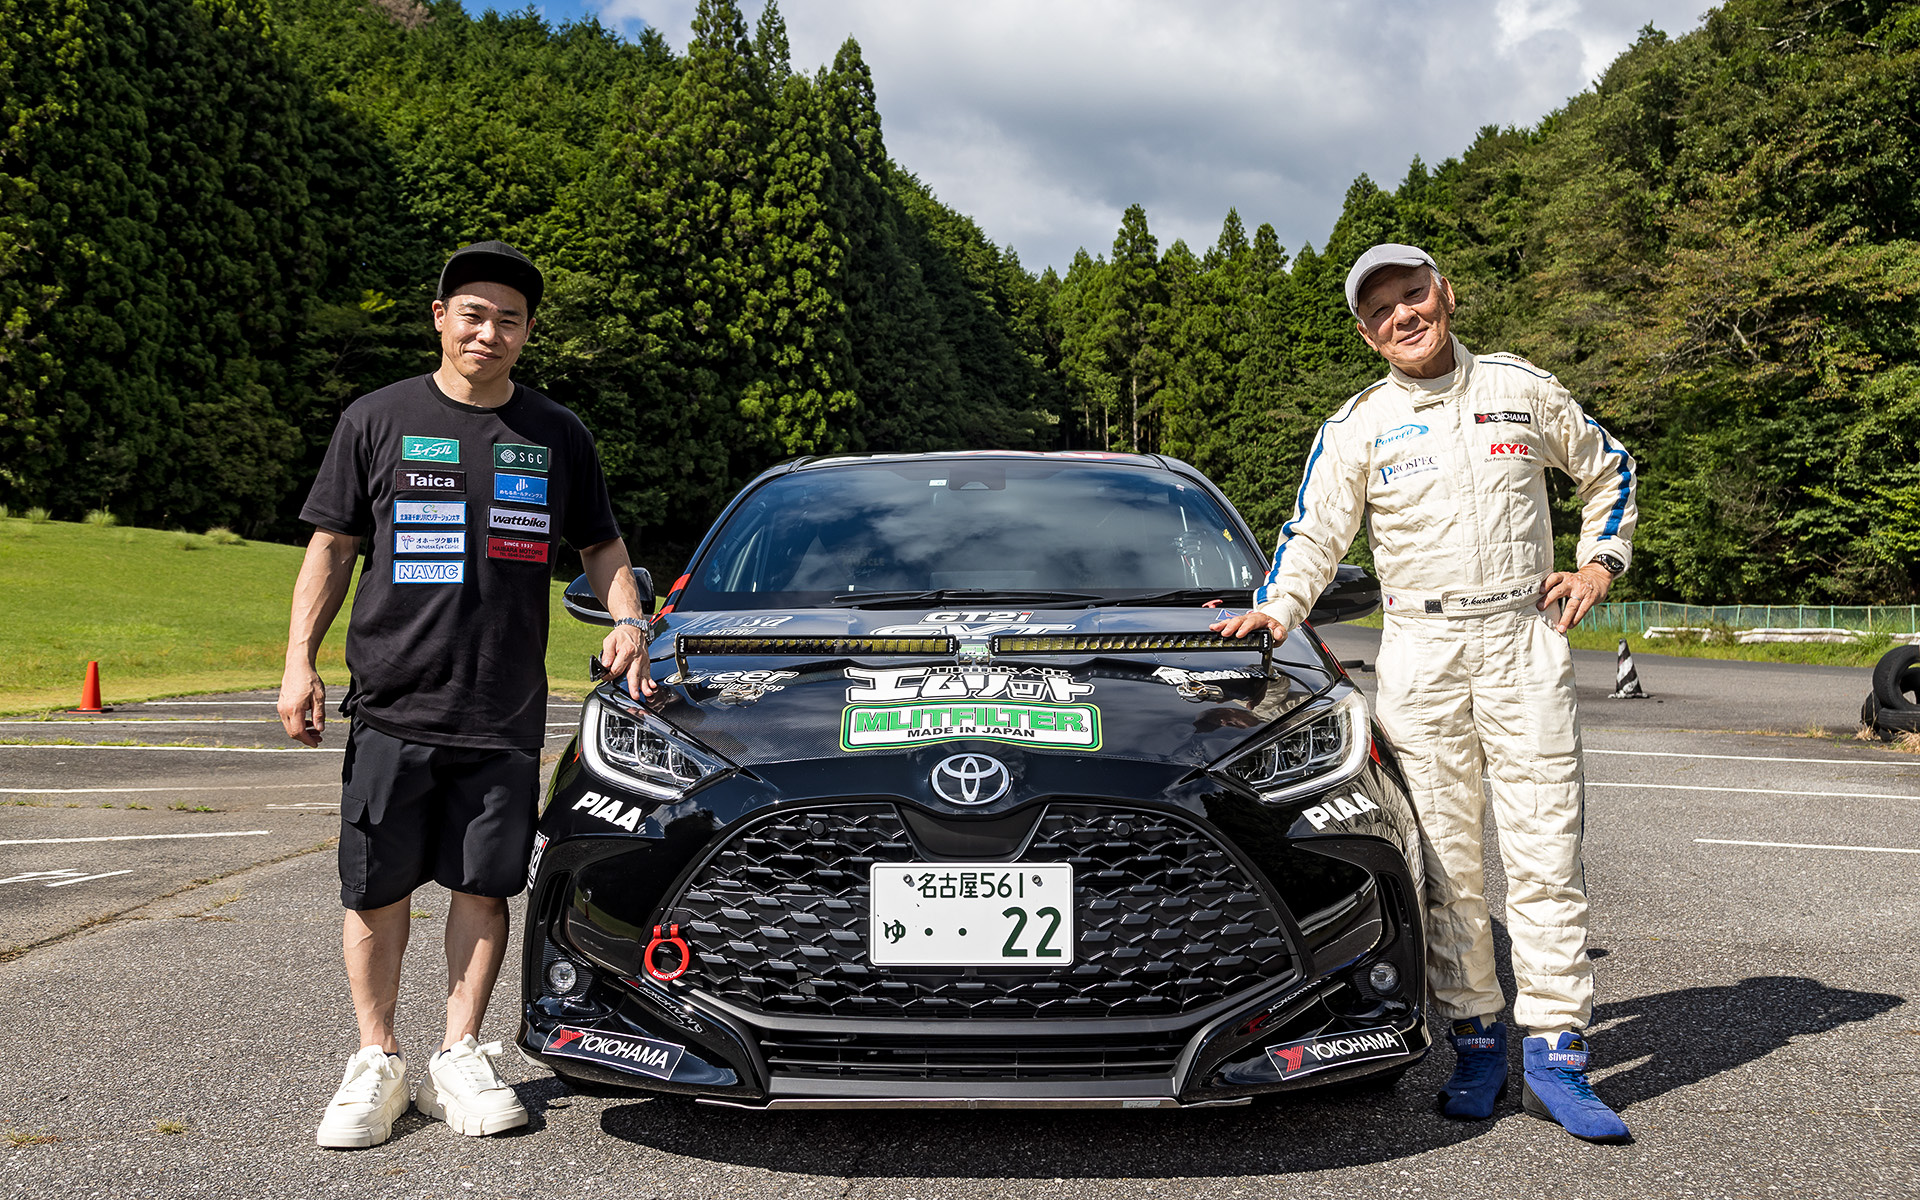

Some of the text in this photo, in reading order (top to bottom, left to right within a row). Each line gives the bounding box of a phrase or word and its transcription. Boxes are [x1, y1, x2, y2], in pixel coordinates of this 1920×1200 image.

[1488, 412, 1530, 422] YOKOHAMA
[407, 442, 453, 458] エイブル
[519, 451, 543, 465] SGC
[405, 473, 455, 488] Taica
[1380, 455, 1438, 486] PROSPEC
[493, 515, 547, 528] wattbike
[398, 564, 459, 580] NAVIC
[924, 611, 1032, 623] GT2i
[844, 667, 1095, 703] エムリット
[854, 706, 1083, 733] MLITFILTER
[907, 726, 1035, 738] MADE IN JAPAN
[571, 791, 642, 832] PIAA
[1302, 792, 1380, 831] PIAA
[883, 919, 906, 944] ゆ
[576, 1032, 670, 1070] YOKOHAMA
[1304, 1032, 1400, 1060] YOKOHAMA
